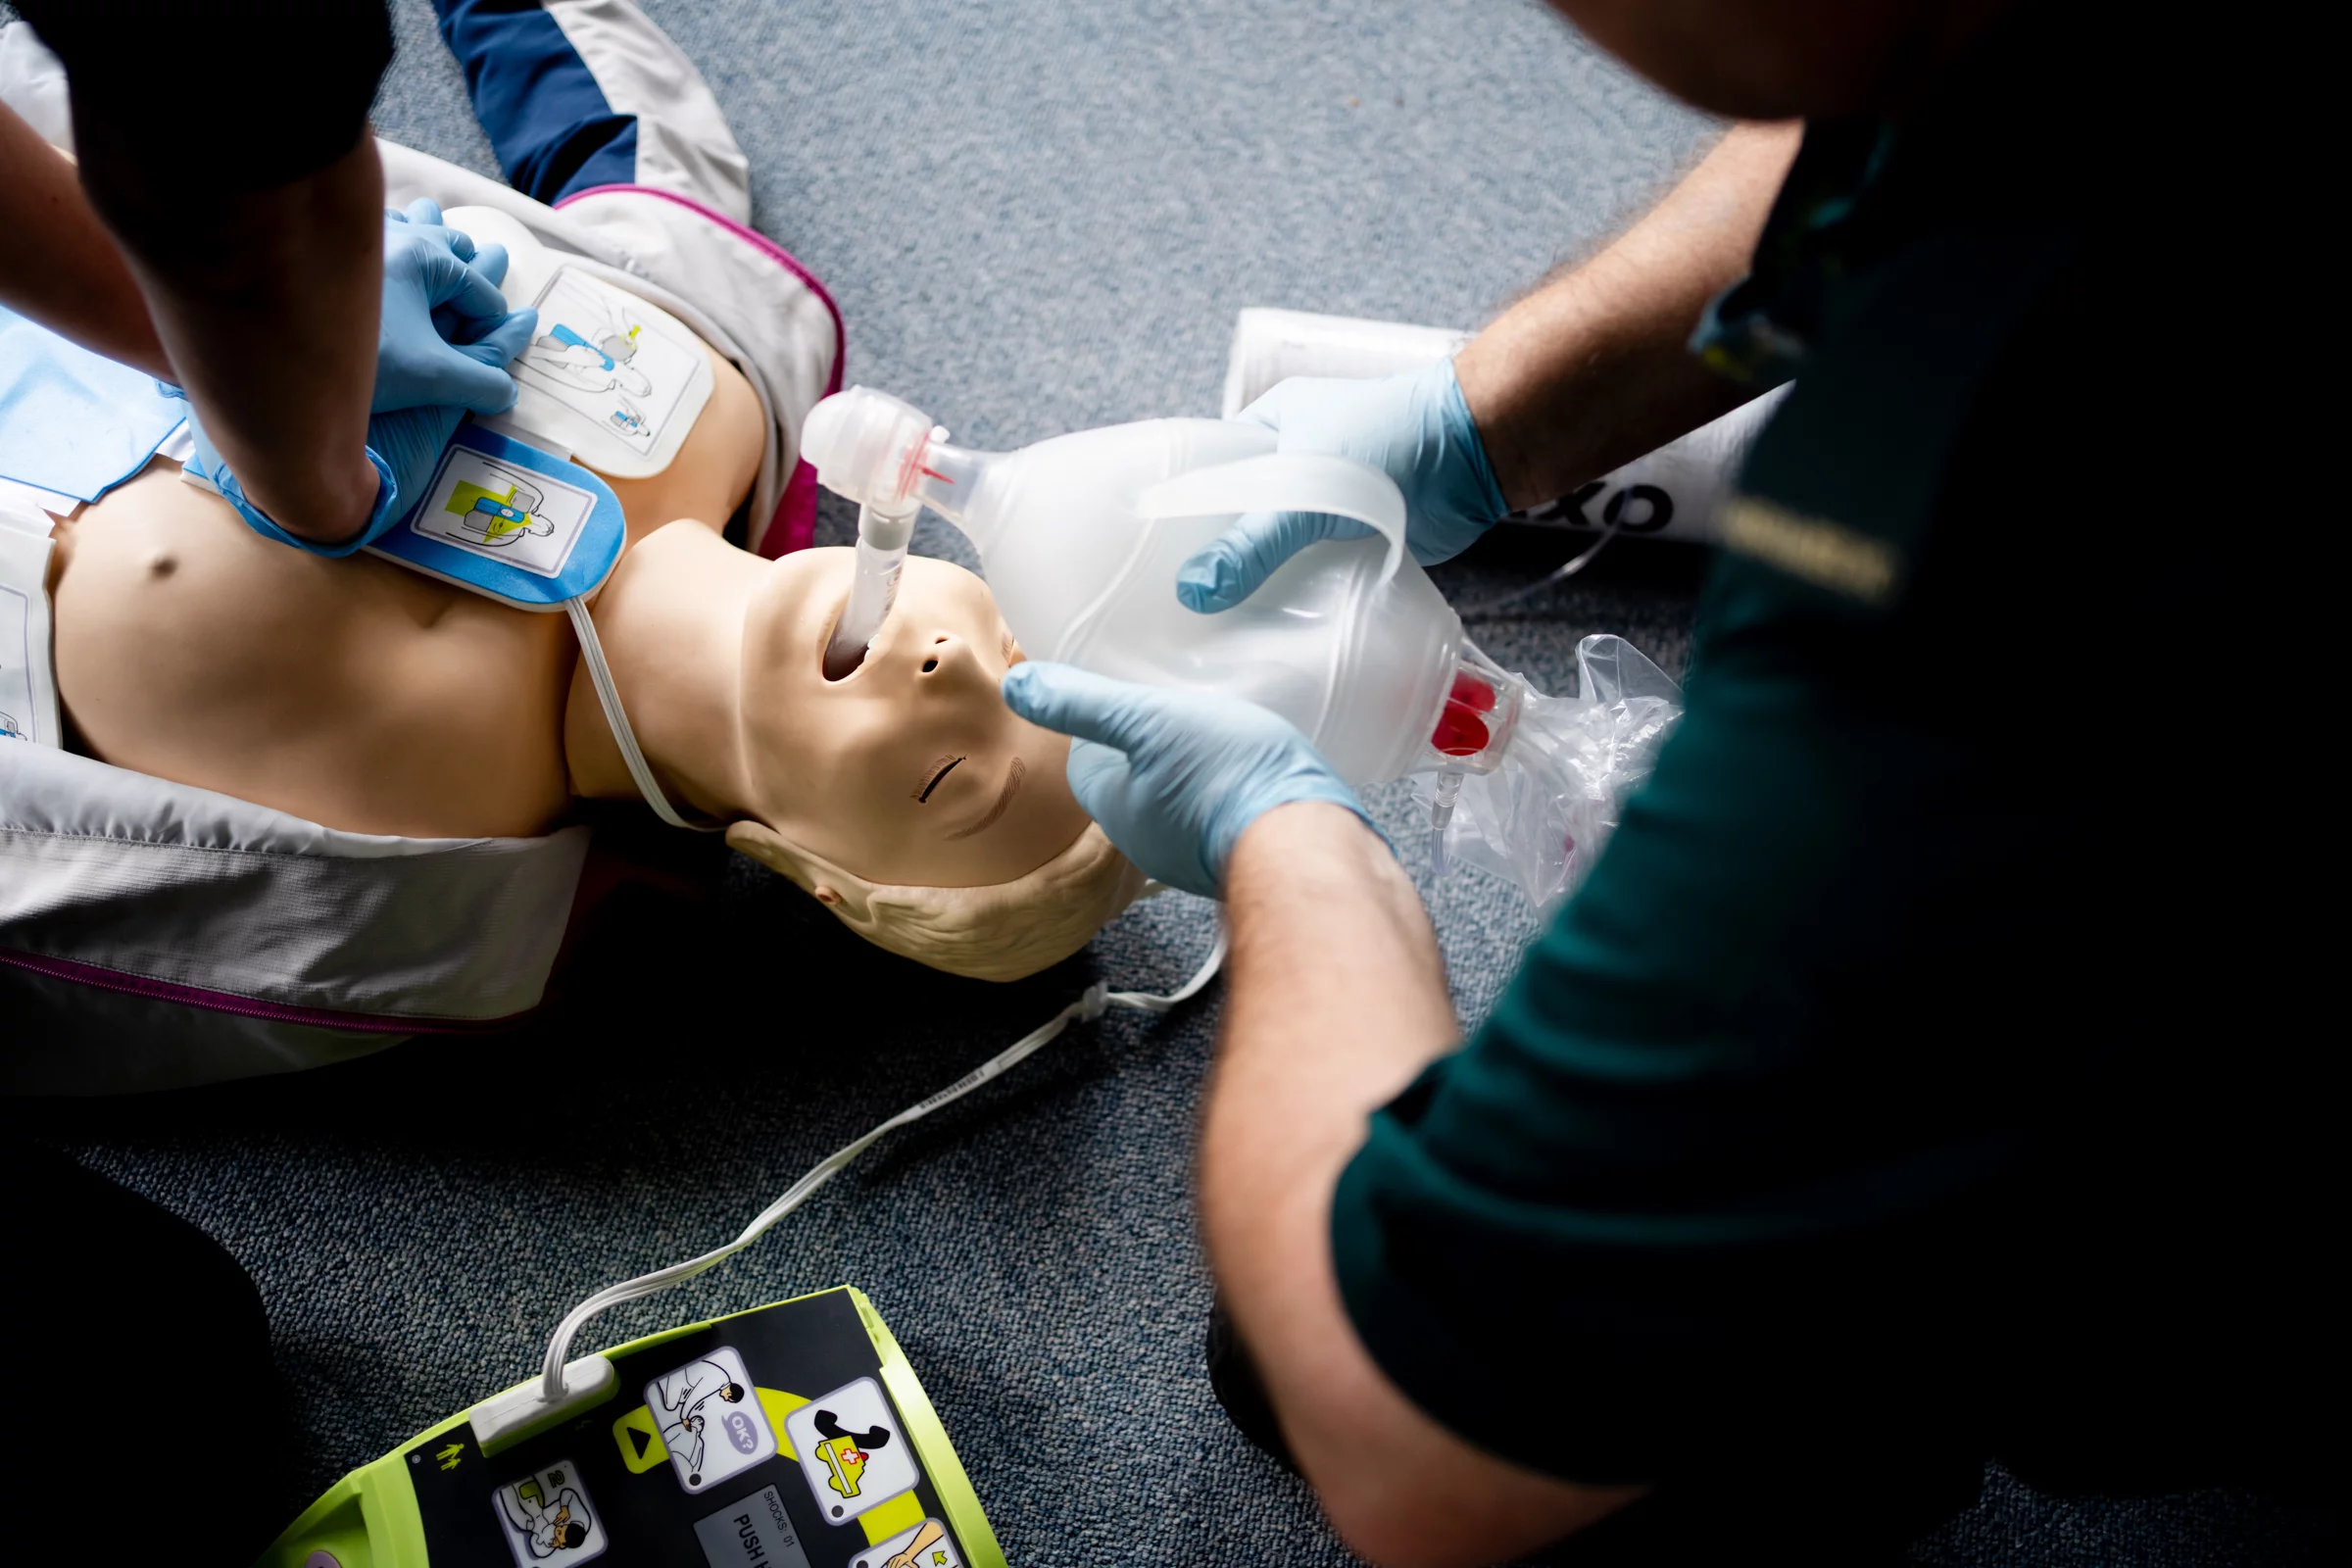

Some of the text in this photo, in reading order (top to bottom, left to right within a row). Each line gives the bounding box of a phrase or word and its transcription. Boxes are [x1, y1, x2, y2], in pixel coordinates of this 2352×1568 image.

[731, 1415, 754, 1449] OK?
[547, 1470, 565, 1489] 2
[733, 1513, 765, 1561] PUSH
[763, 1491, 796, 1547] SHOCKS: 01
